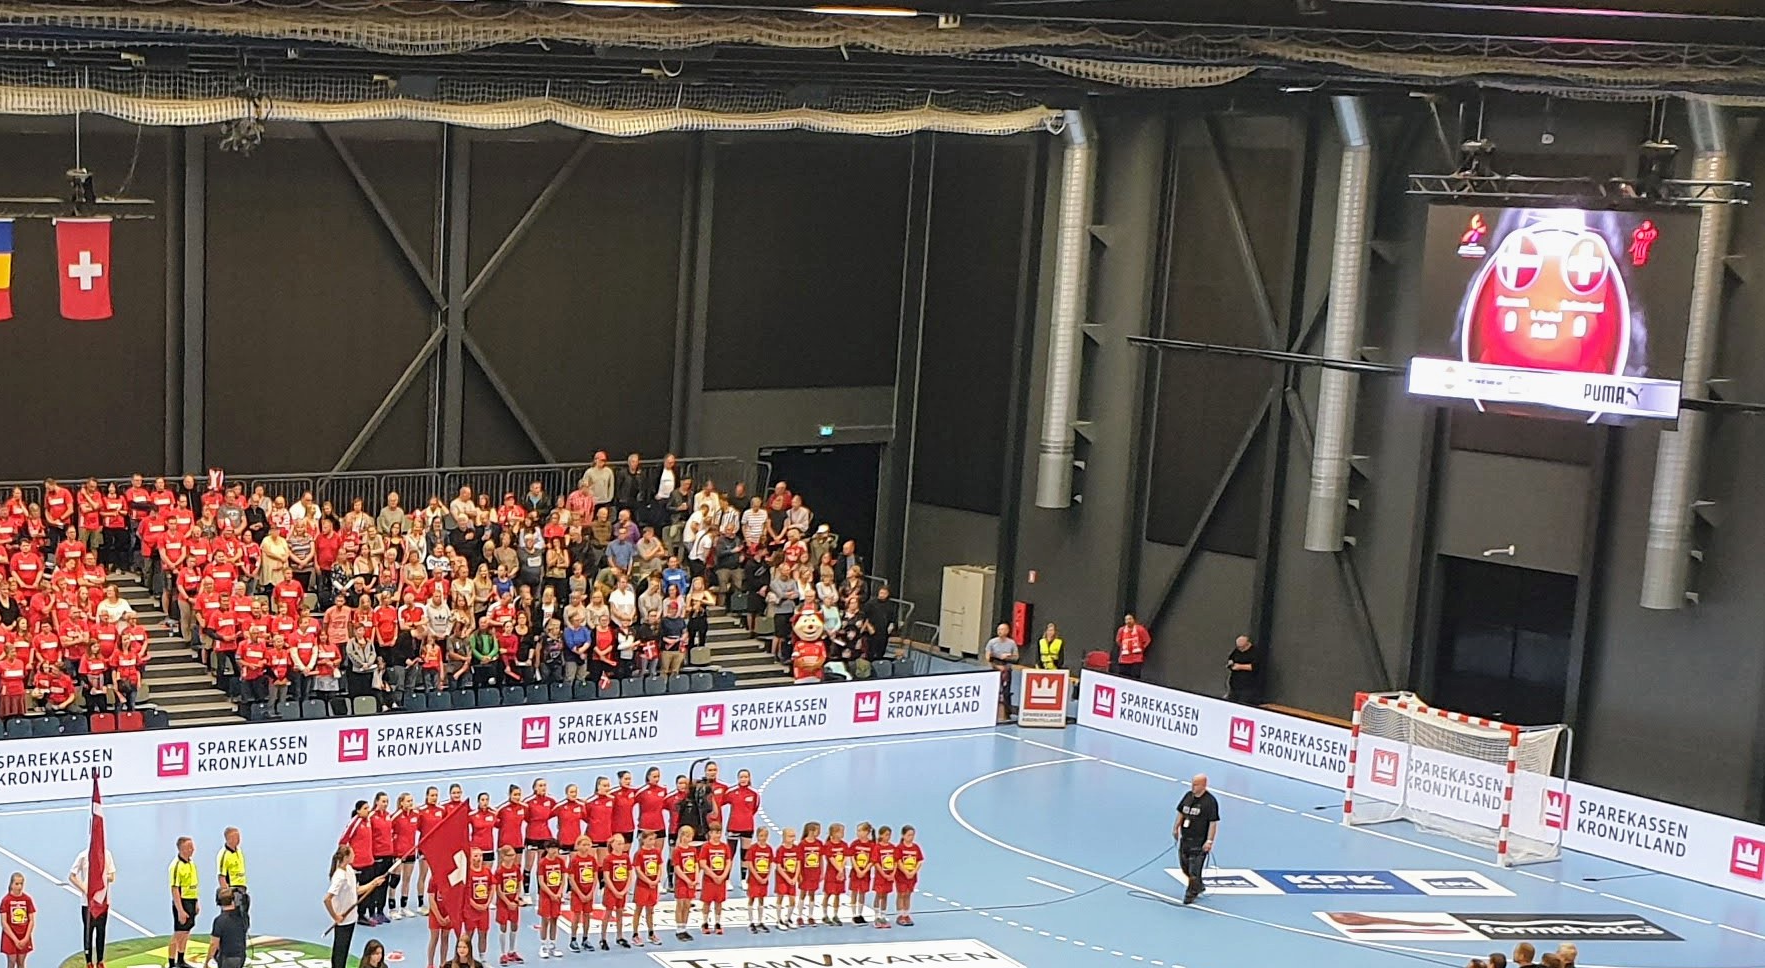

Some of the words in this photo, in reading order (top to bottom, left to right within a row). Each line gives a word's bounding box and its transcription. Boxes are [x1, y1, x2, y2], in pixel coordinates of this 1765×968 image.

[1584, 383, 1625, 404] PUMA
[888, 685, 981, 704] SPAREKASSEN
[731, 697, 828, 717] SPAREKASSEN
[887, 700, 980, 719] KRONJYLLAND
[1121, 691, 1199, 721] SPAREKASSEN
[558, 710, 659, 730] SPAREKASSEN
[731, 713, 827, 732] KRONJYLLAND
[1119, 707, 1198, 737] KRONJYLLAND
[377, 721, 482, 742] SPAREKASSEN
[558, 725, 658, 745] KRONJYLLAND
[1260, 723, 1348, 757] SPAREKASSEN
[198, 735, 308, 756] SPAREKASSEN
[377, 738, 482, 758] KRONJYLLAND
[198, 752, 308, 772] KRONJYLLAND
[1259, 740, 1346, 774] KRONJYLLAND
[1408, 758, 1503, 793] SPAREKASSEN
[1578, 800, 1688, 839] SPAREKASSEN
[1577, 818, 1686, 857] KRONJYLLAND
[1282, 874, 1386, 885] KPK
[1479, 924, 1665, 935] formthotics
